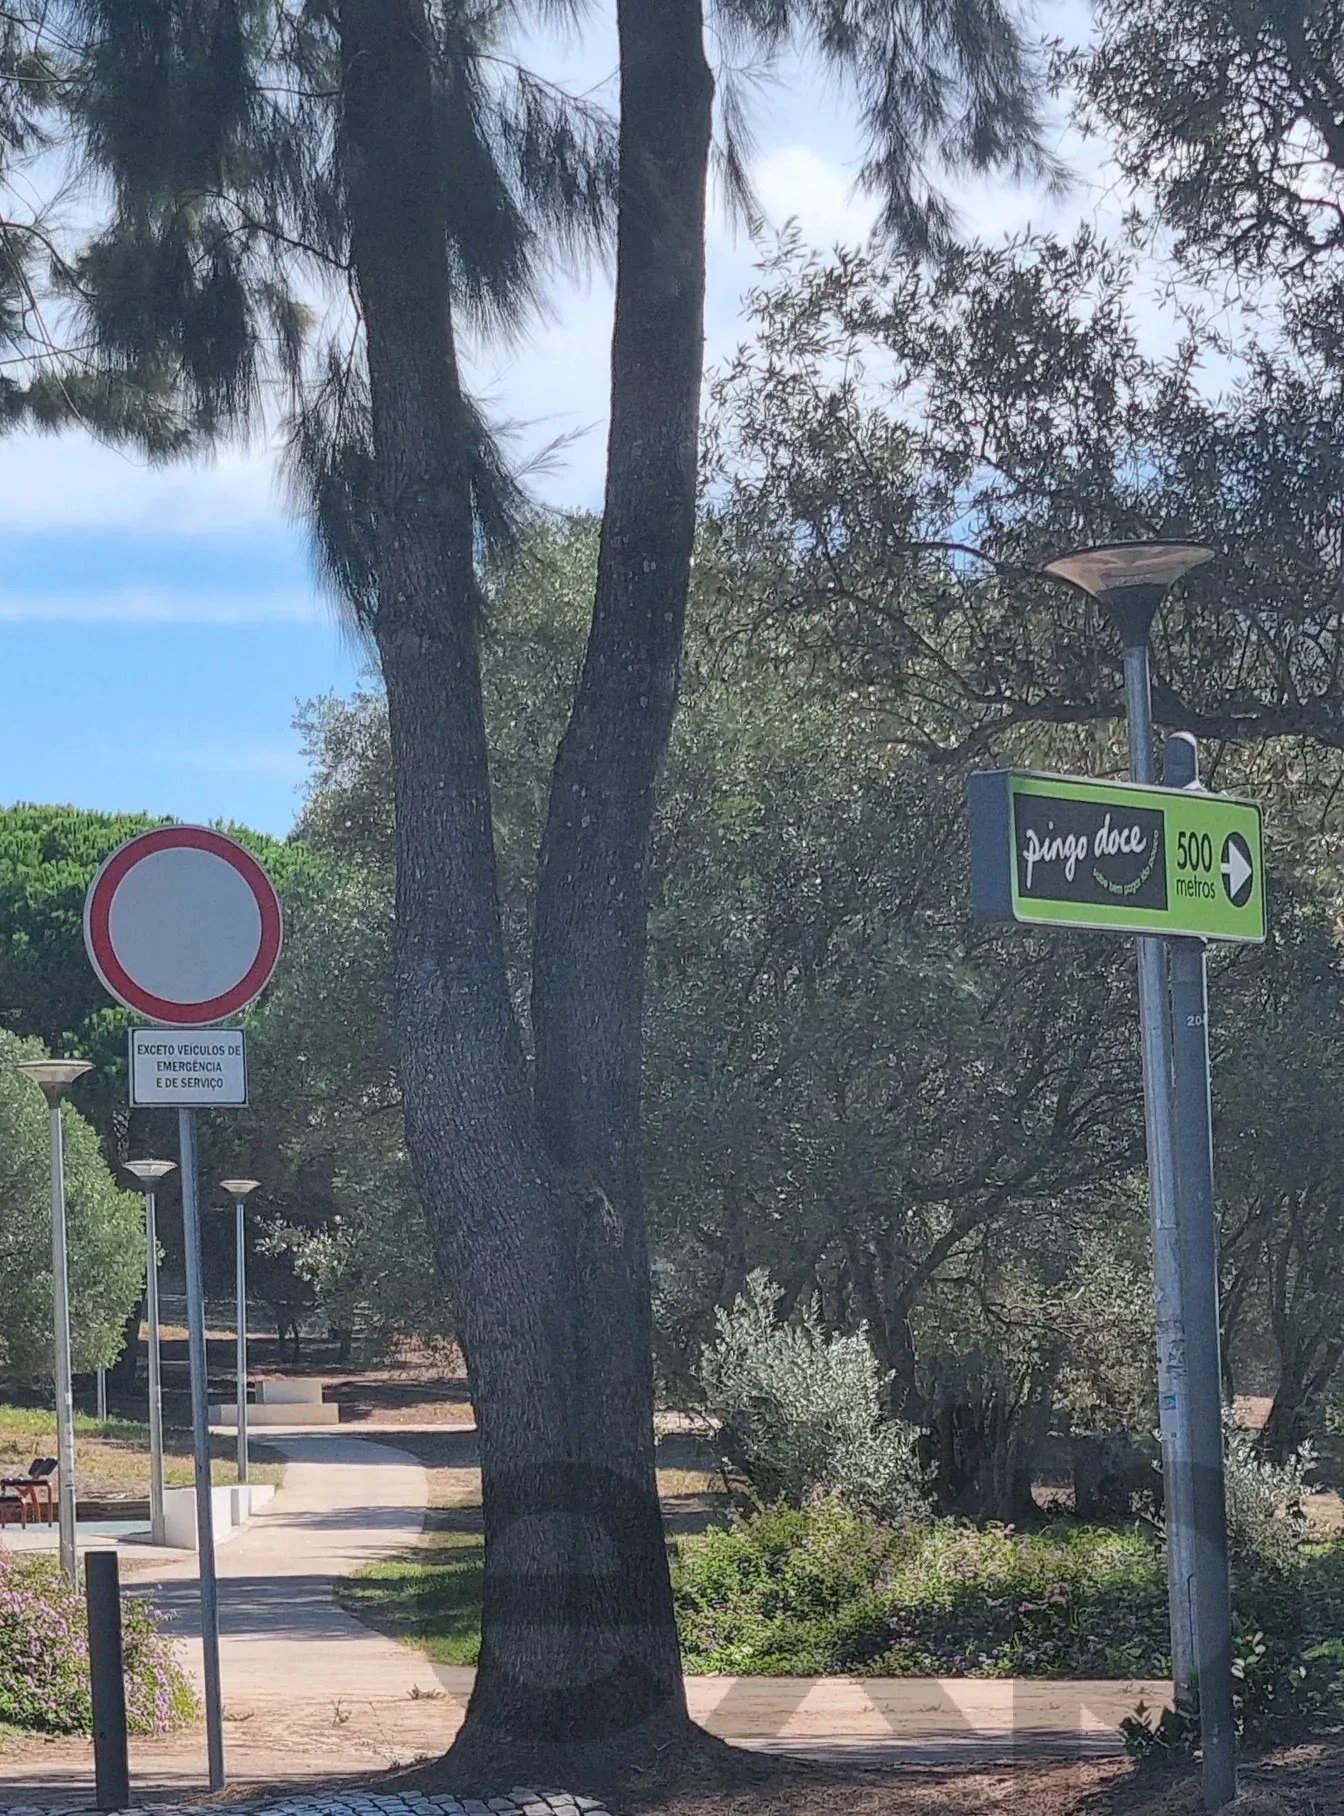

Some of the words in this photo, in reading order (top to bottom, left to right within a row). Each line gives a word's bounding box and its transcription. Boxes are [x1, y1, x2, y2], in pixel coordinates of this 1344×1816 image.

[1023, 820, 1088, 889] pingo
[1093, 812, 1147, 858] doce
[1177, 831, 1213, 873] 500
[1176, 874, 1216, 899] metros
[137, 1044, 175, 1056] EXCETO
[177, 1042, 225, 1056] VEÍCULOS
[228, 1045, 241, 1056] DE
[156, 1059, 223, 1073] EMERGÊNCIA
[156, 1078, 163, 1088] E
[165, 1078, 179, 1089] DE
[180, 1078, 224, 1091] SERVIÇO
